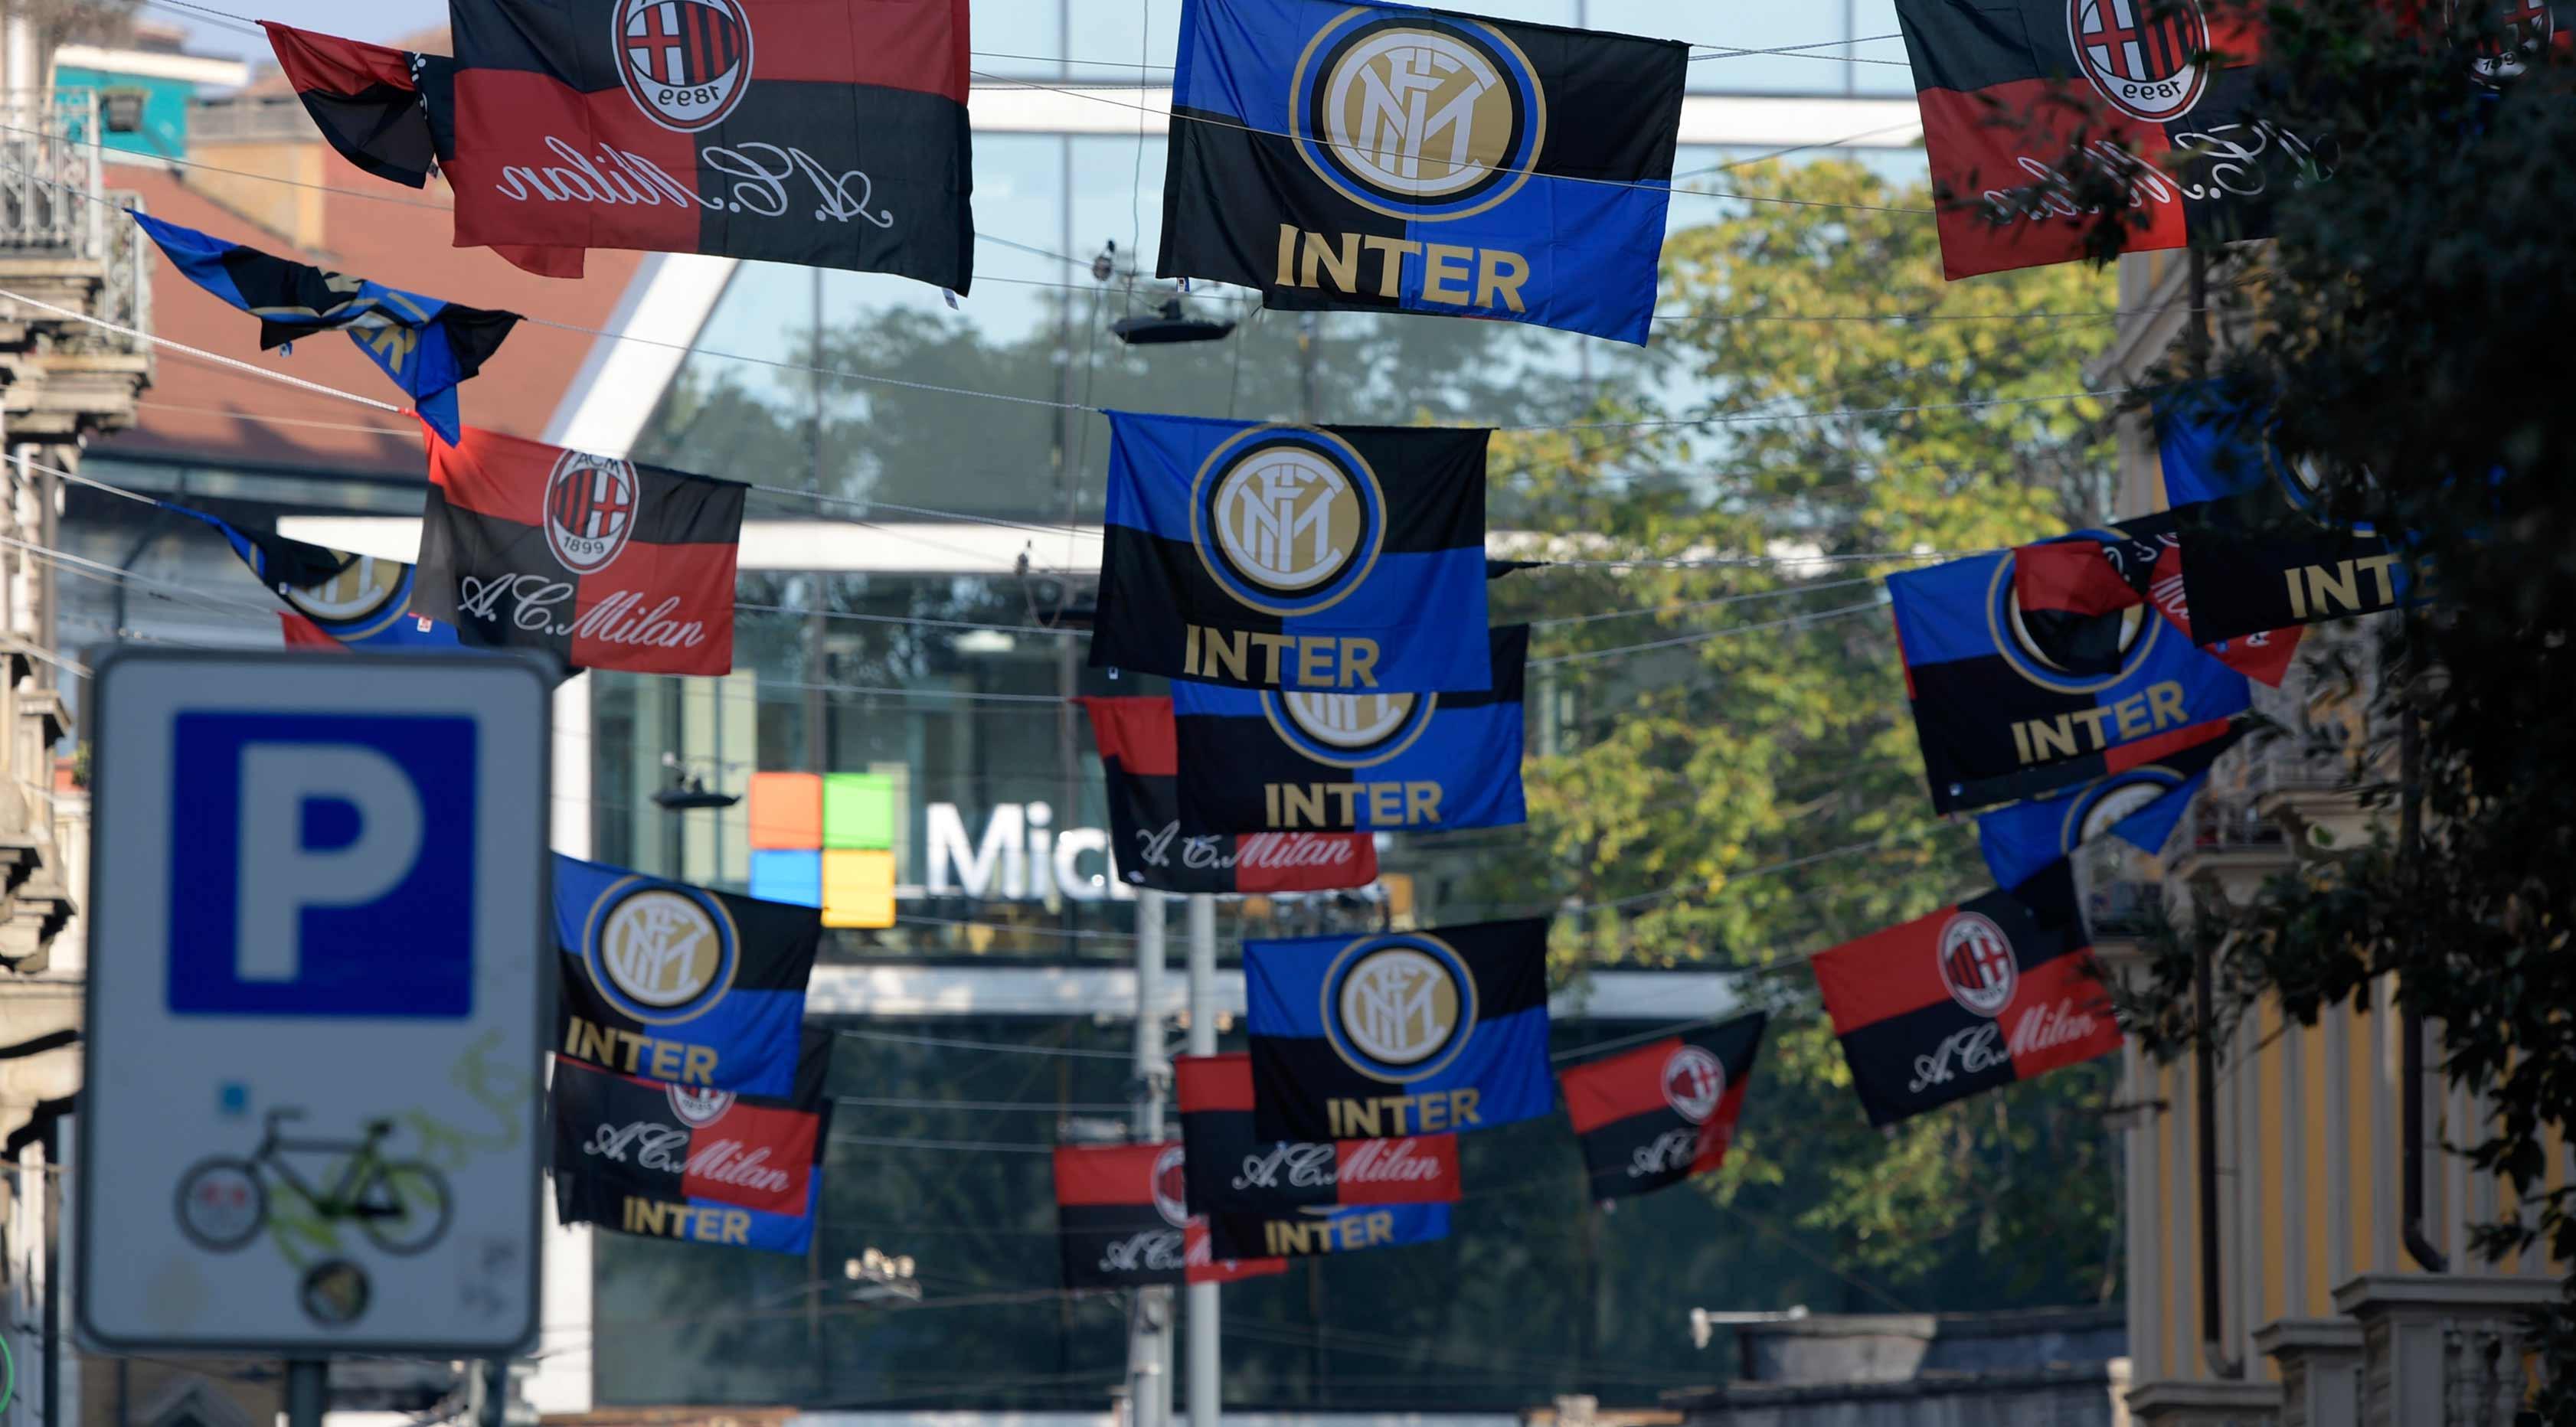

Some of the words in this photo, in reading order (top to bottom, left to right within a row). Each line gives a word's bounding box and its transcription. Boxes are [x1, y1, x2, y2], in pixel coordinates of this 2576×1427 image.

[1275, 223, 1530, 313] INTER
[563, 536, 606, 555] 1899
[1184, 624, 1381, 688] INTER
[2011, 679, 2189, 765] INTER
[1264, 781, 1444, 828] INTER
[234, 742, 427, 985] P
[564, 1016, 719, 1086] INTER
[1327, 1087, 1483, 1138] INTER
[623, 1195, 752, 1246] INTER
[1263, 1210, 1394, 1256] INTER
